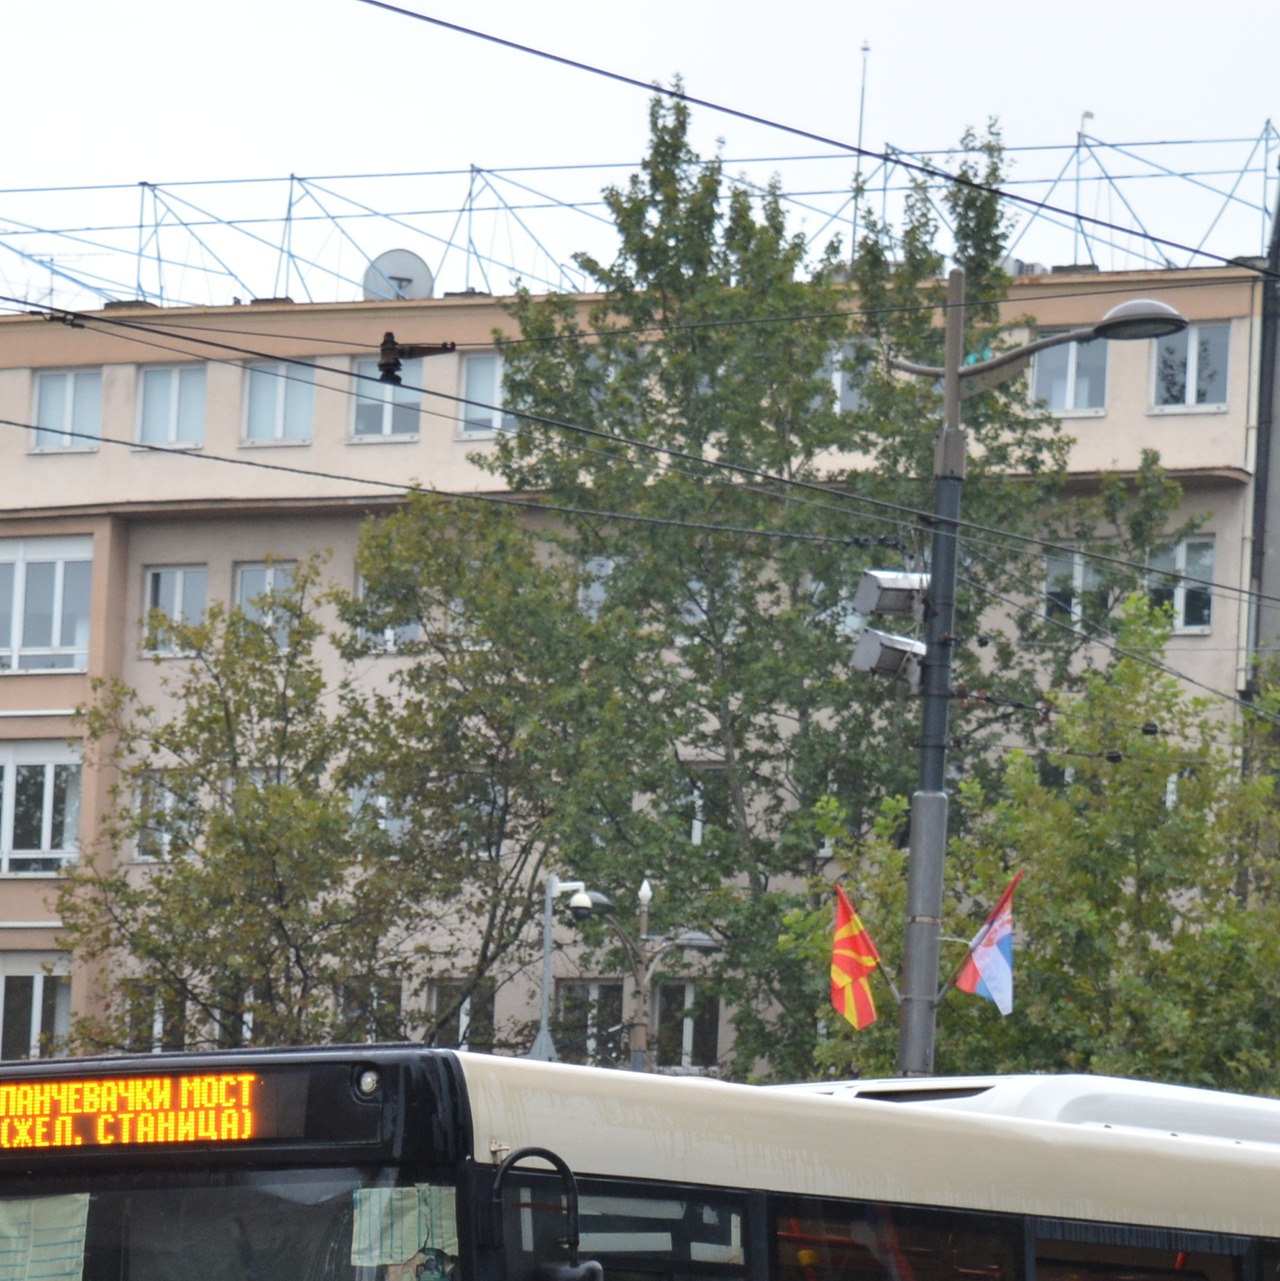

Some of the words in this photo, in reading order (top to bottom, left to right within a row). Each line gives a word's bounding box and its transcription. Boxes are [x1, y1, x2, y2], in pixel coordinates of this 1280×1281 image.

[181, 1074, 255, 1109] МОСТ
[0, 1115, 83, 1148] (ЖЕЛ.
[96, 1109, 252, 1145] СТАНИЦА)
